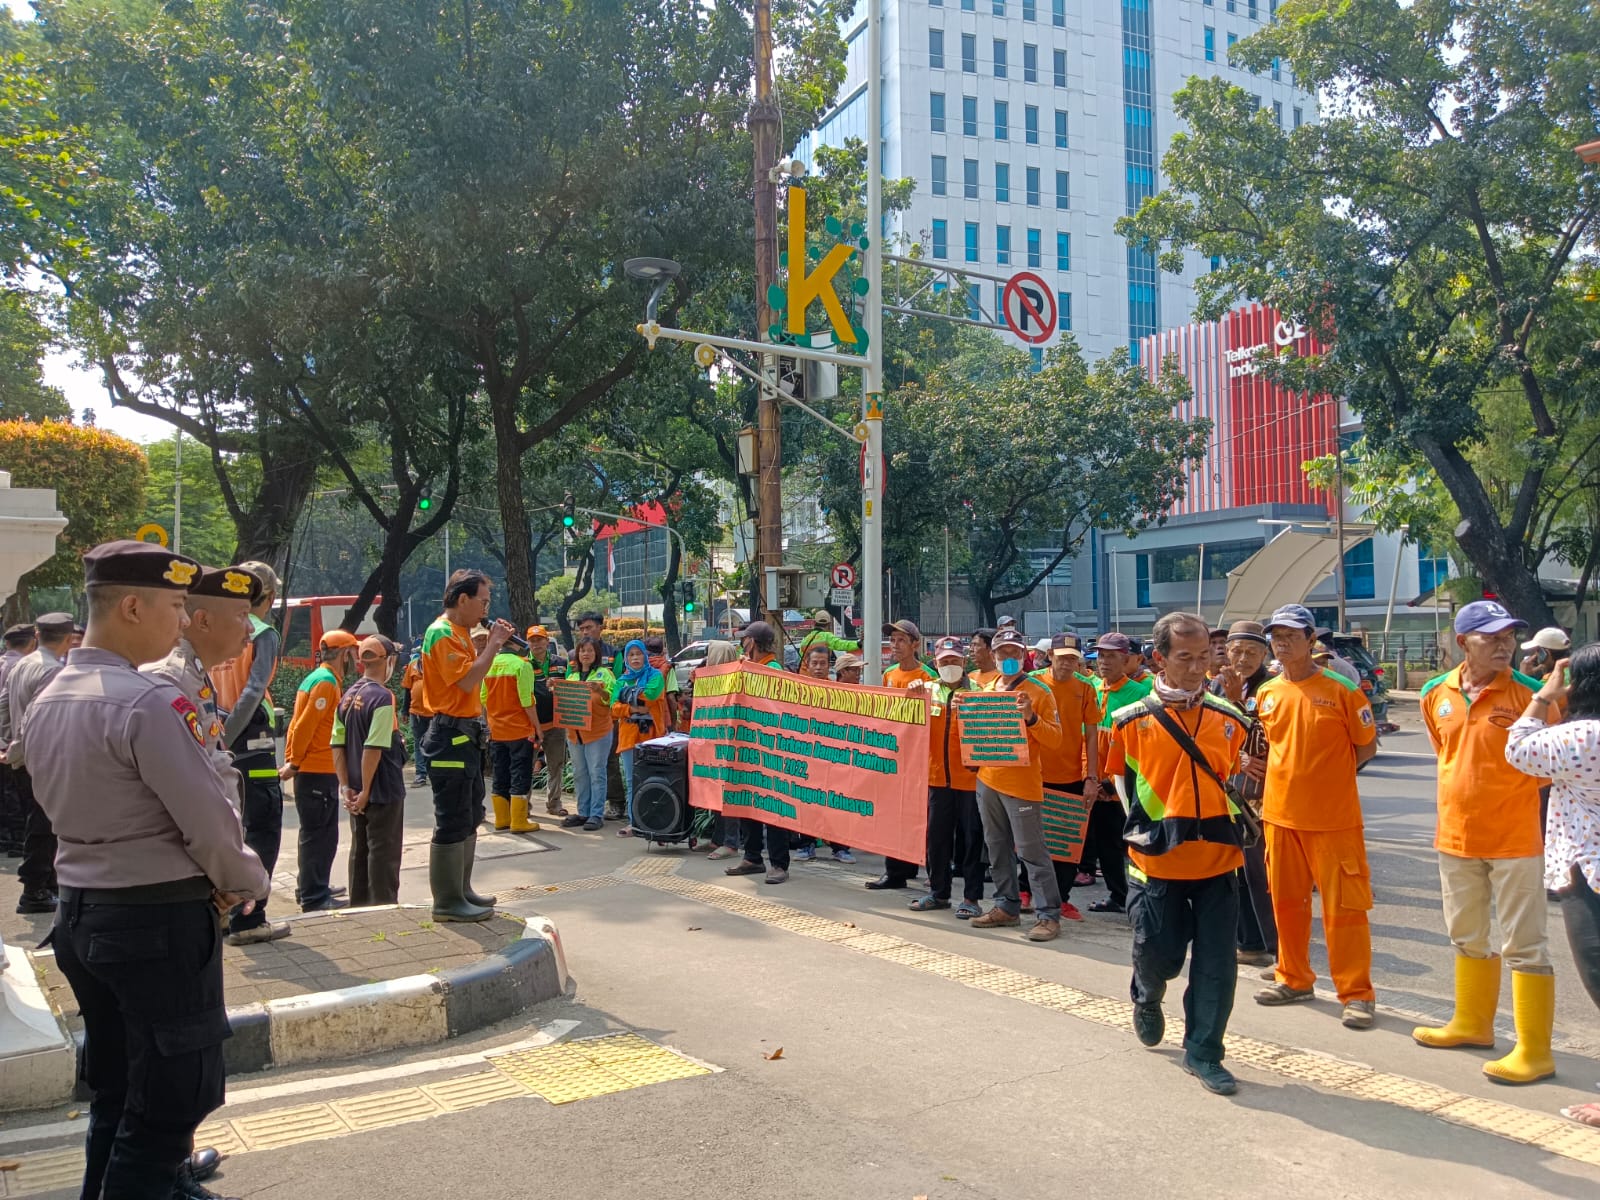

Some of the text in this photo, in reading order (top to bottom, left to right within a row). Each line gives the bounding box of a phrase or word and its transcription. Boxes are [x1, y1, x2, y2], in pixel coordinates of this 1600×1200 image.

[1020, 286, 1043, 331] P
[743, 672, 769, 698] TAHUN
[768, 676, 781, 700] KE
[780, 679, 799, 703] ATAS
[828, 688, 857, 713] BADAN
[857, 692, 873, 716] AIR
[887, 696, 926, 725] JAKARTA
[780, 712, 809, 734] Hidup
[810, 717, 848, 741] Provinsi
[736, 725, 757, 743] Atas
[776, 733, 813, 757] Terkena
[813, 741, 851, 766] Dampak
[852, 748, 897, 774] Terbitnya
[737, 746, 760, 766] 1095
[783, 756, 809, 780] 2022,
[790, 781, 827, 806] Anggota
[827, 790, 874, 817] Keluarga
